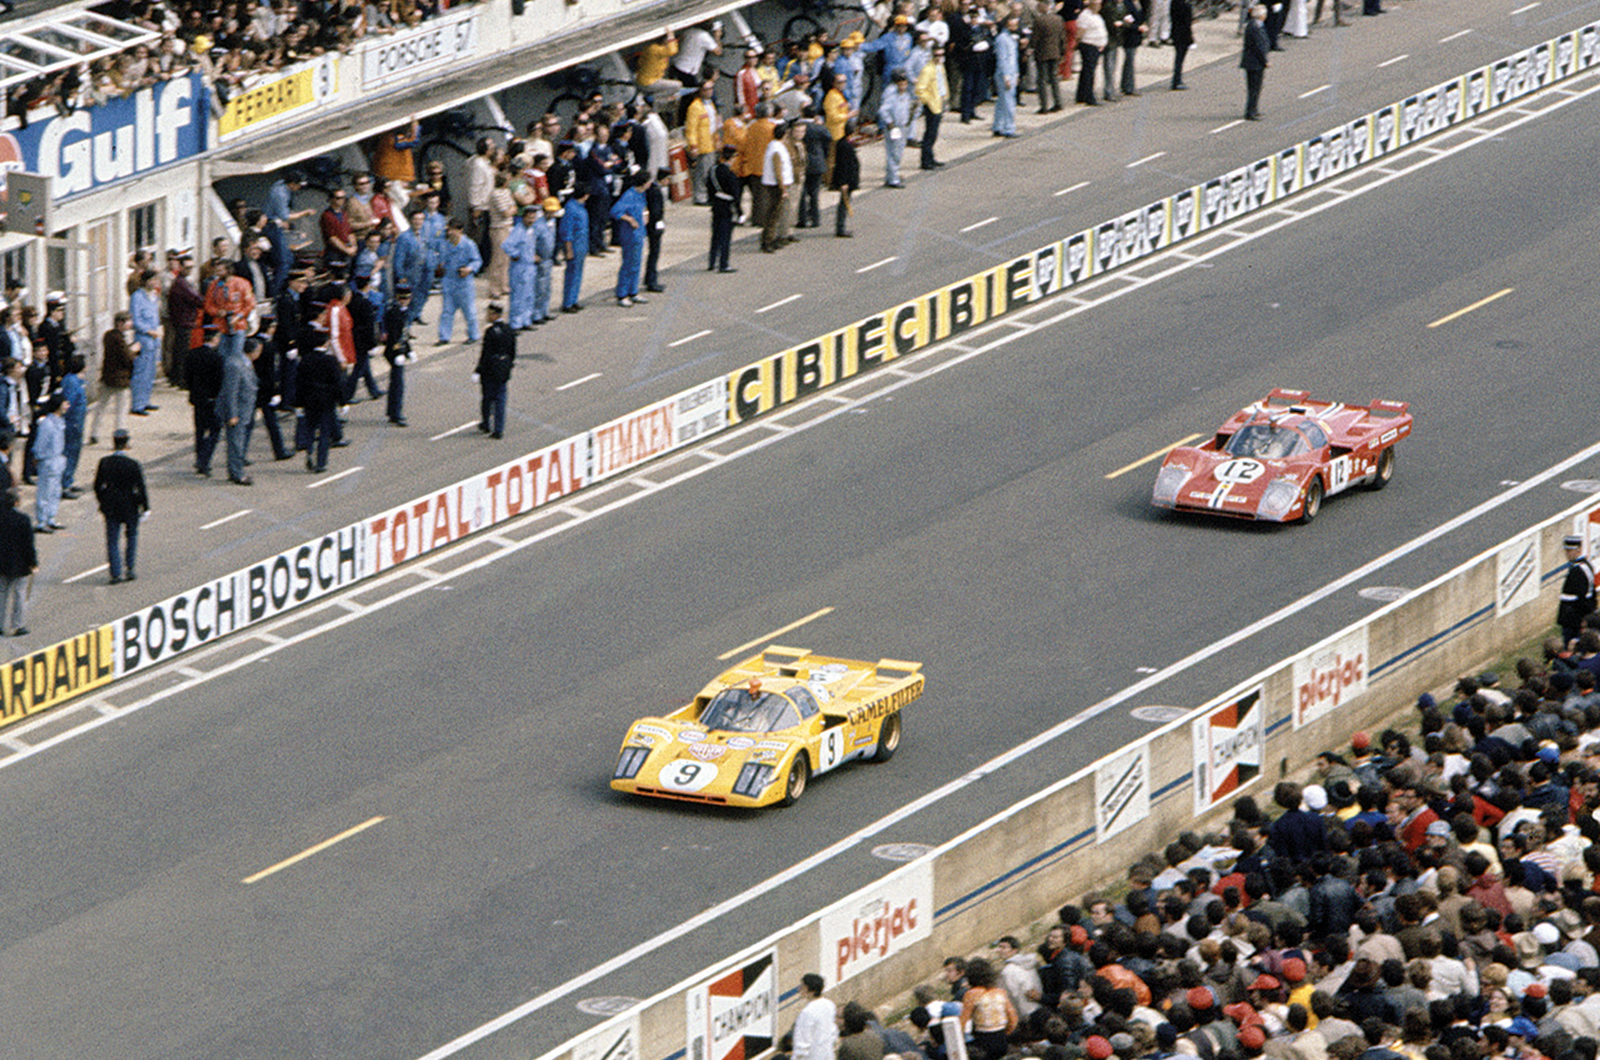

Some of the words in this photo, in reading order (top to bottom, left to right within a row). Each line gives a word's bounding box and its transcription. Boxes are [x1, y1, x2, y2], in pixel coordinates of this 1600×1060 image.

[378, 31, 441, 75] PORSCHE
[38, 77, 192, 200] Gulf
[895, 258, 1032, 354] CIBIE
[735, 315, 886, 421] CIBIE
[596, 402, 675, 475] TIMKEN
[1223, 461, 1259, 480] 12
[1334, 459, 1345, 486] 12
[487, 442, 583, 525] TOTAL
[371, 486, 471, 573] TOTAL
[250, 526, 357, 622] BOSCH
[123, 577, 235, 673] BOSCH
[674, 764, 701, 786] 9
[828, 731, 836, 766] 9
